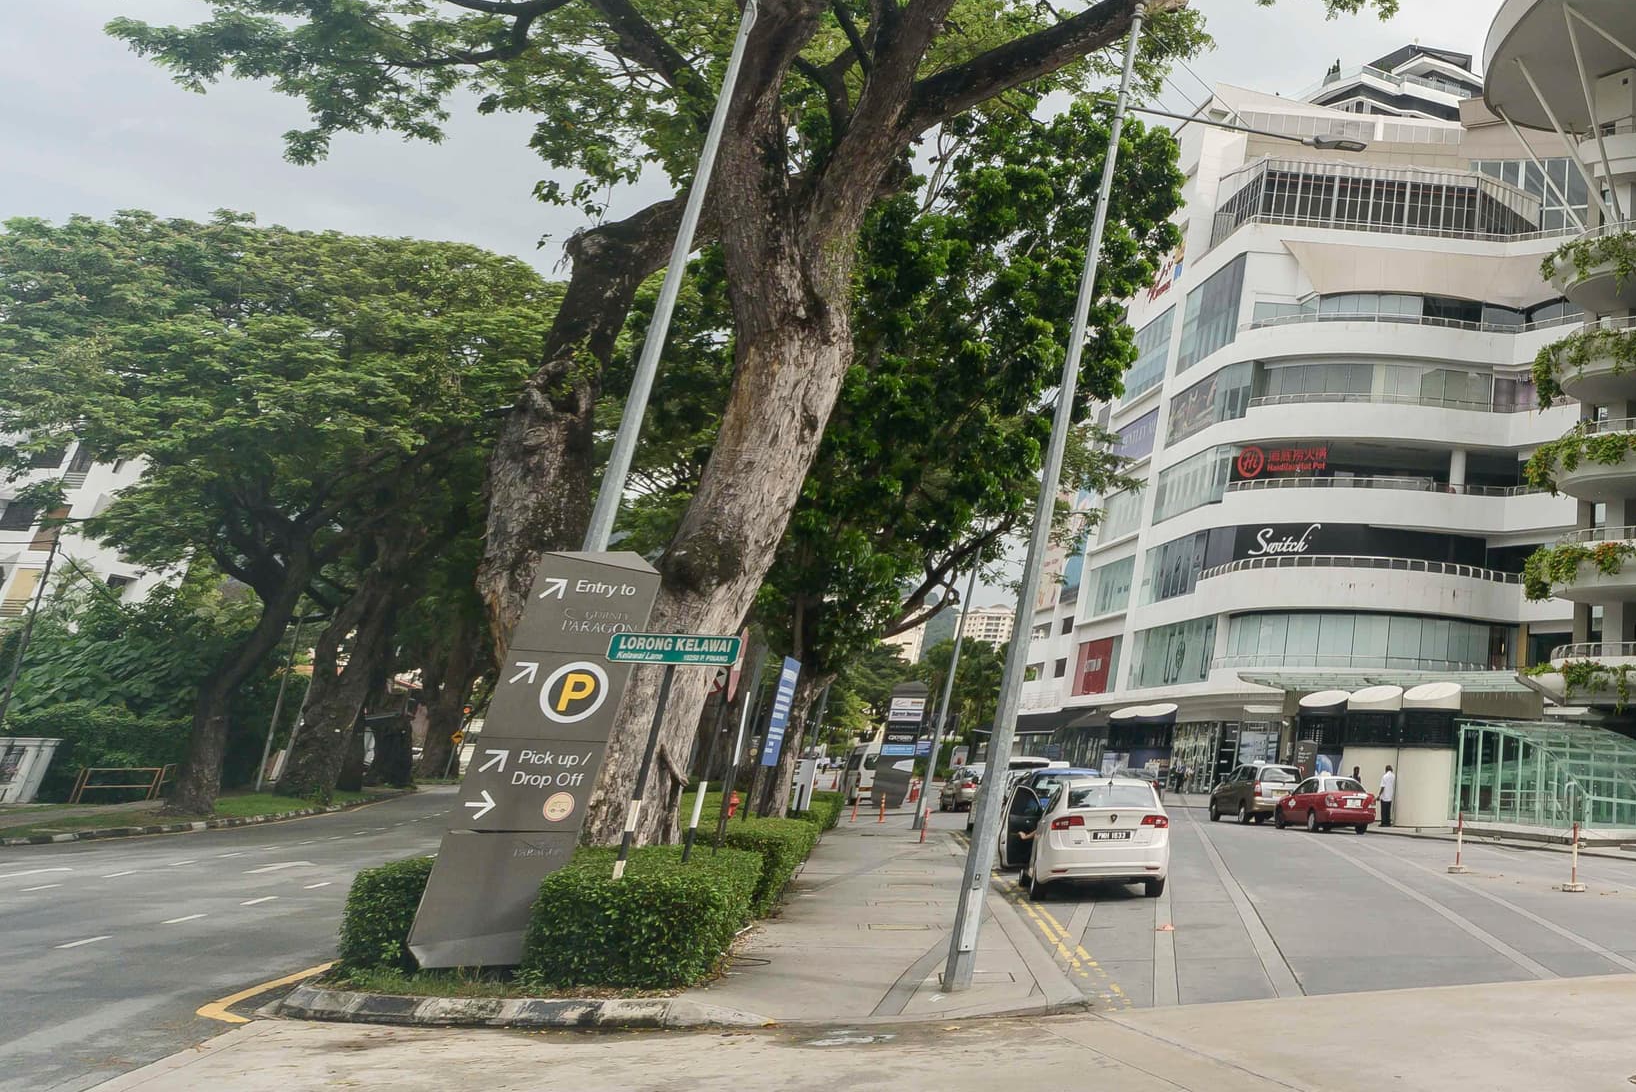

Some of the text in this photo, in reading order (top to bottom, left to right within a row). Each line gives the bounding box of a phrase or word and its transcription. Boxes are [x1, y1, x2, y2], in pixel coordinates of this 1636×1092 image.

[1247, 523, 1322, 555] Switch
[576, 579, 637, 598] Entry to
[561, 619, 639, 634] PARAGON
[619, 636, 732, 653] LORONG KELAWAI
[556, 673, 596, 712] P
[518, 750, 555, 766] Pick
[558, 756, 580, 769] up
[511, 771, 585, 789] Drop Off
